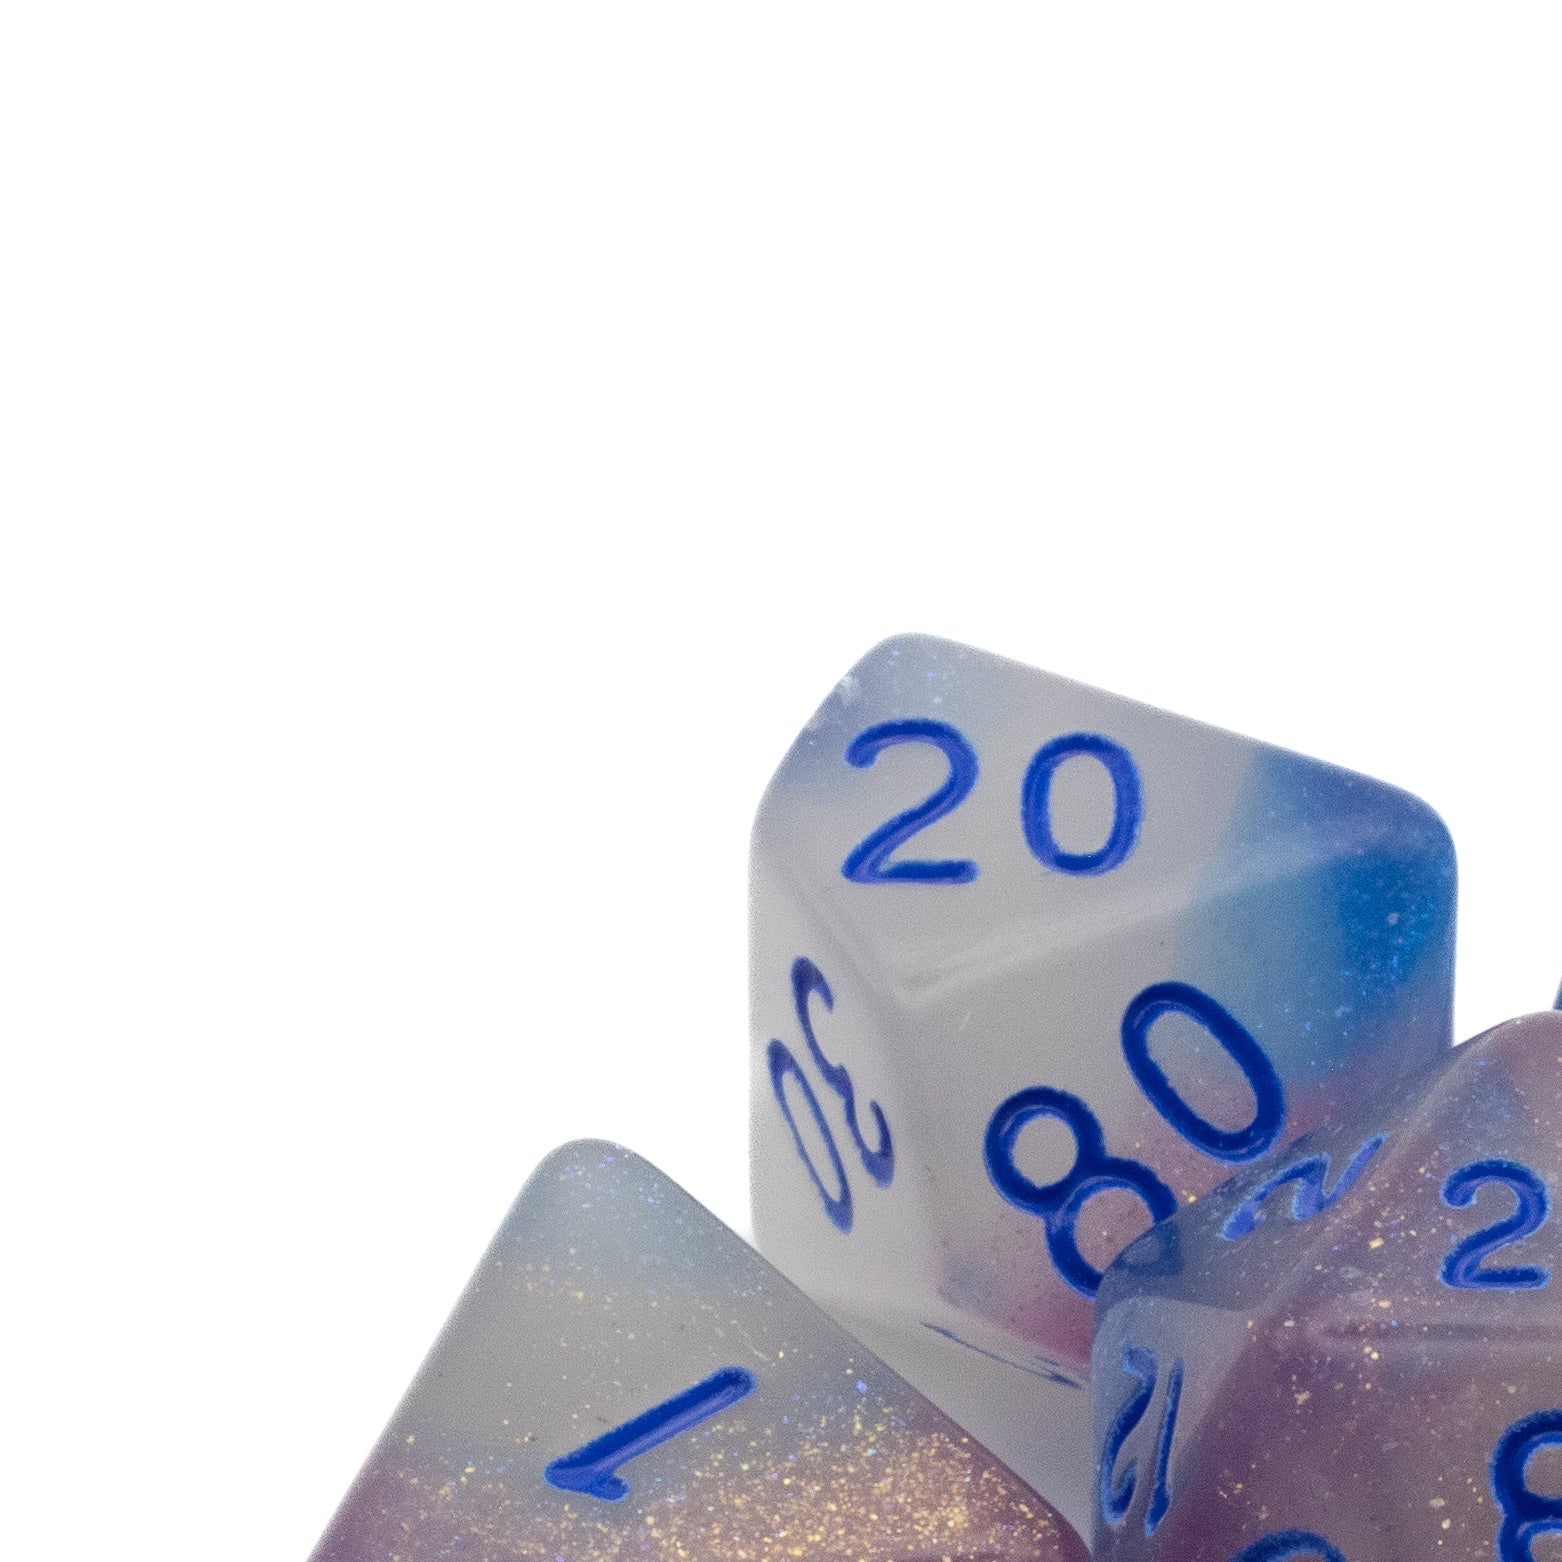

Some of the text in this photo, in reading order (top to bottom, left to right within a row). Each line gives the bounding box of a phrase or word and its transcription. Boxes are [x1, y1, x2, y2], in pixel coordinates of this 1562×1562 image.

[838, 716, 1145, 886] 20
[765, 954, 896, 1235] 30
[983, 980, 1287, 1300] 80
[543, 1365, 757, 1503] 1
[1098, 1340, 1186, 1538] 12
